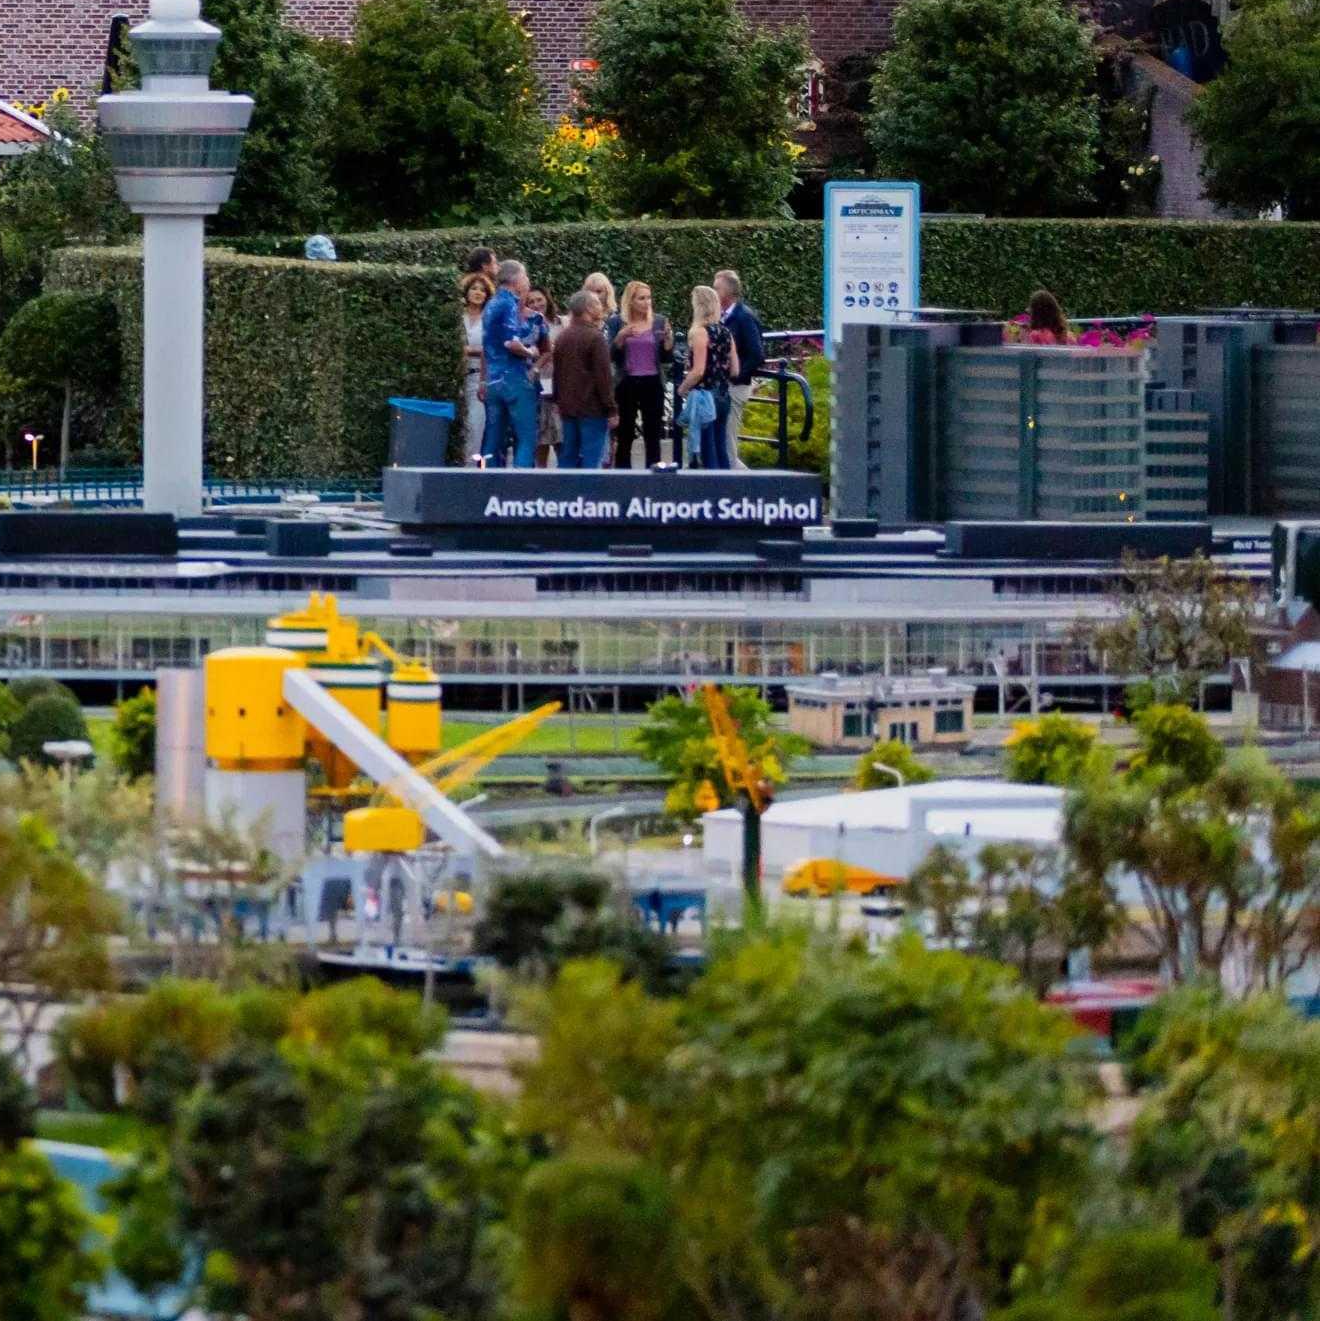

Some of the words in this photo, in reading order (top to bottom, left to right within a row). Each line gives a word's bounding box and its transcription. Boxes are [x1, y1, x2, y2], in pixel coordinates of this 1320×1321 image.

[484, 495, 619, 518] Amsterdam
[625, 496, 713, 523] Airport
[717, 497, 817, 524] Schiphol
